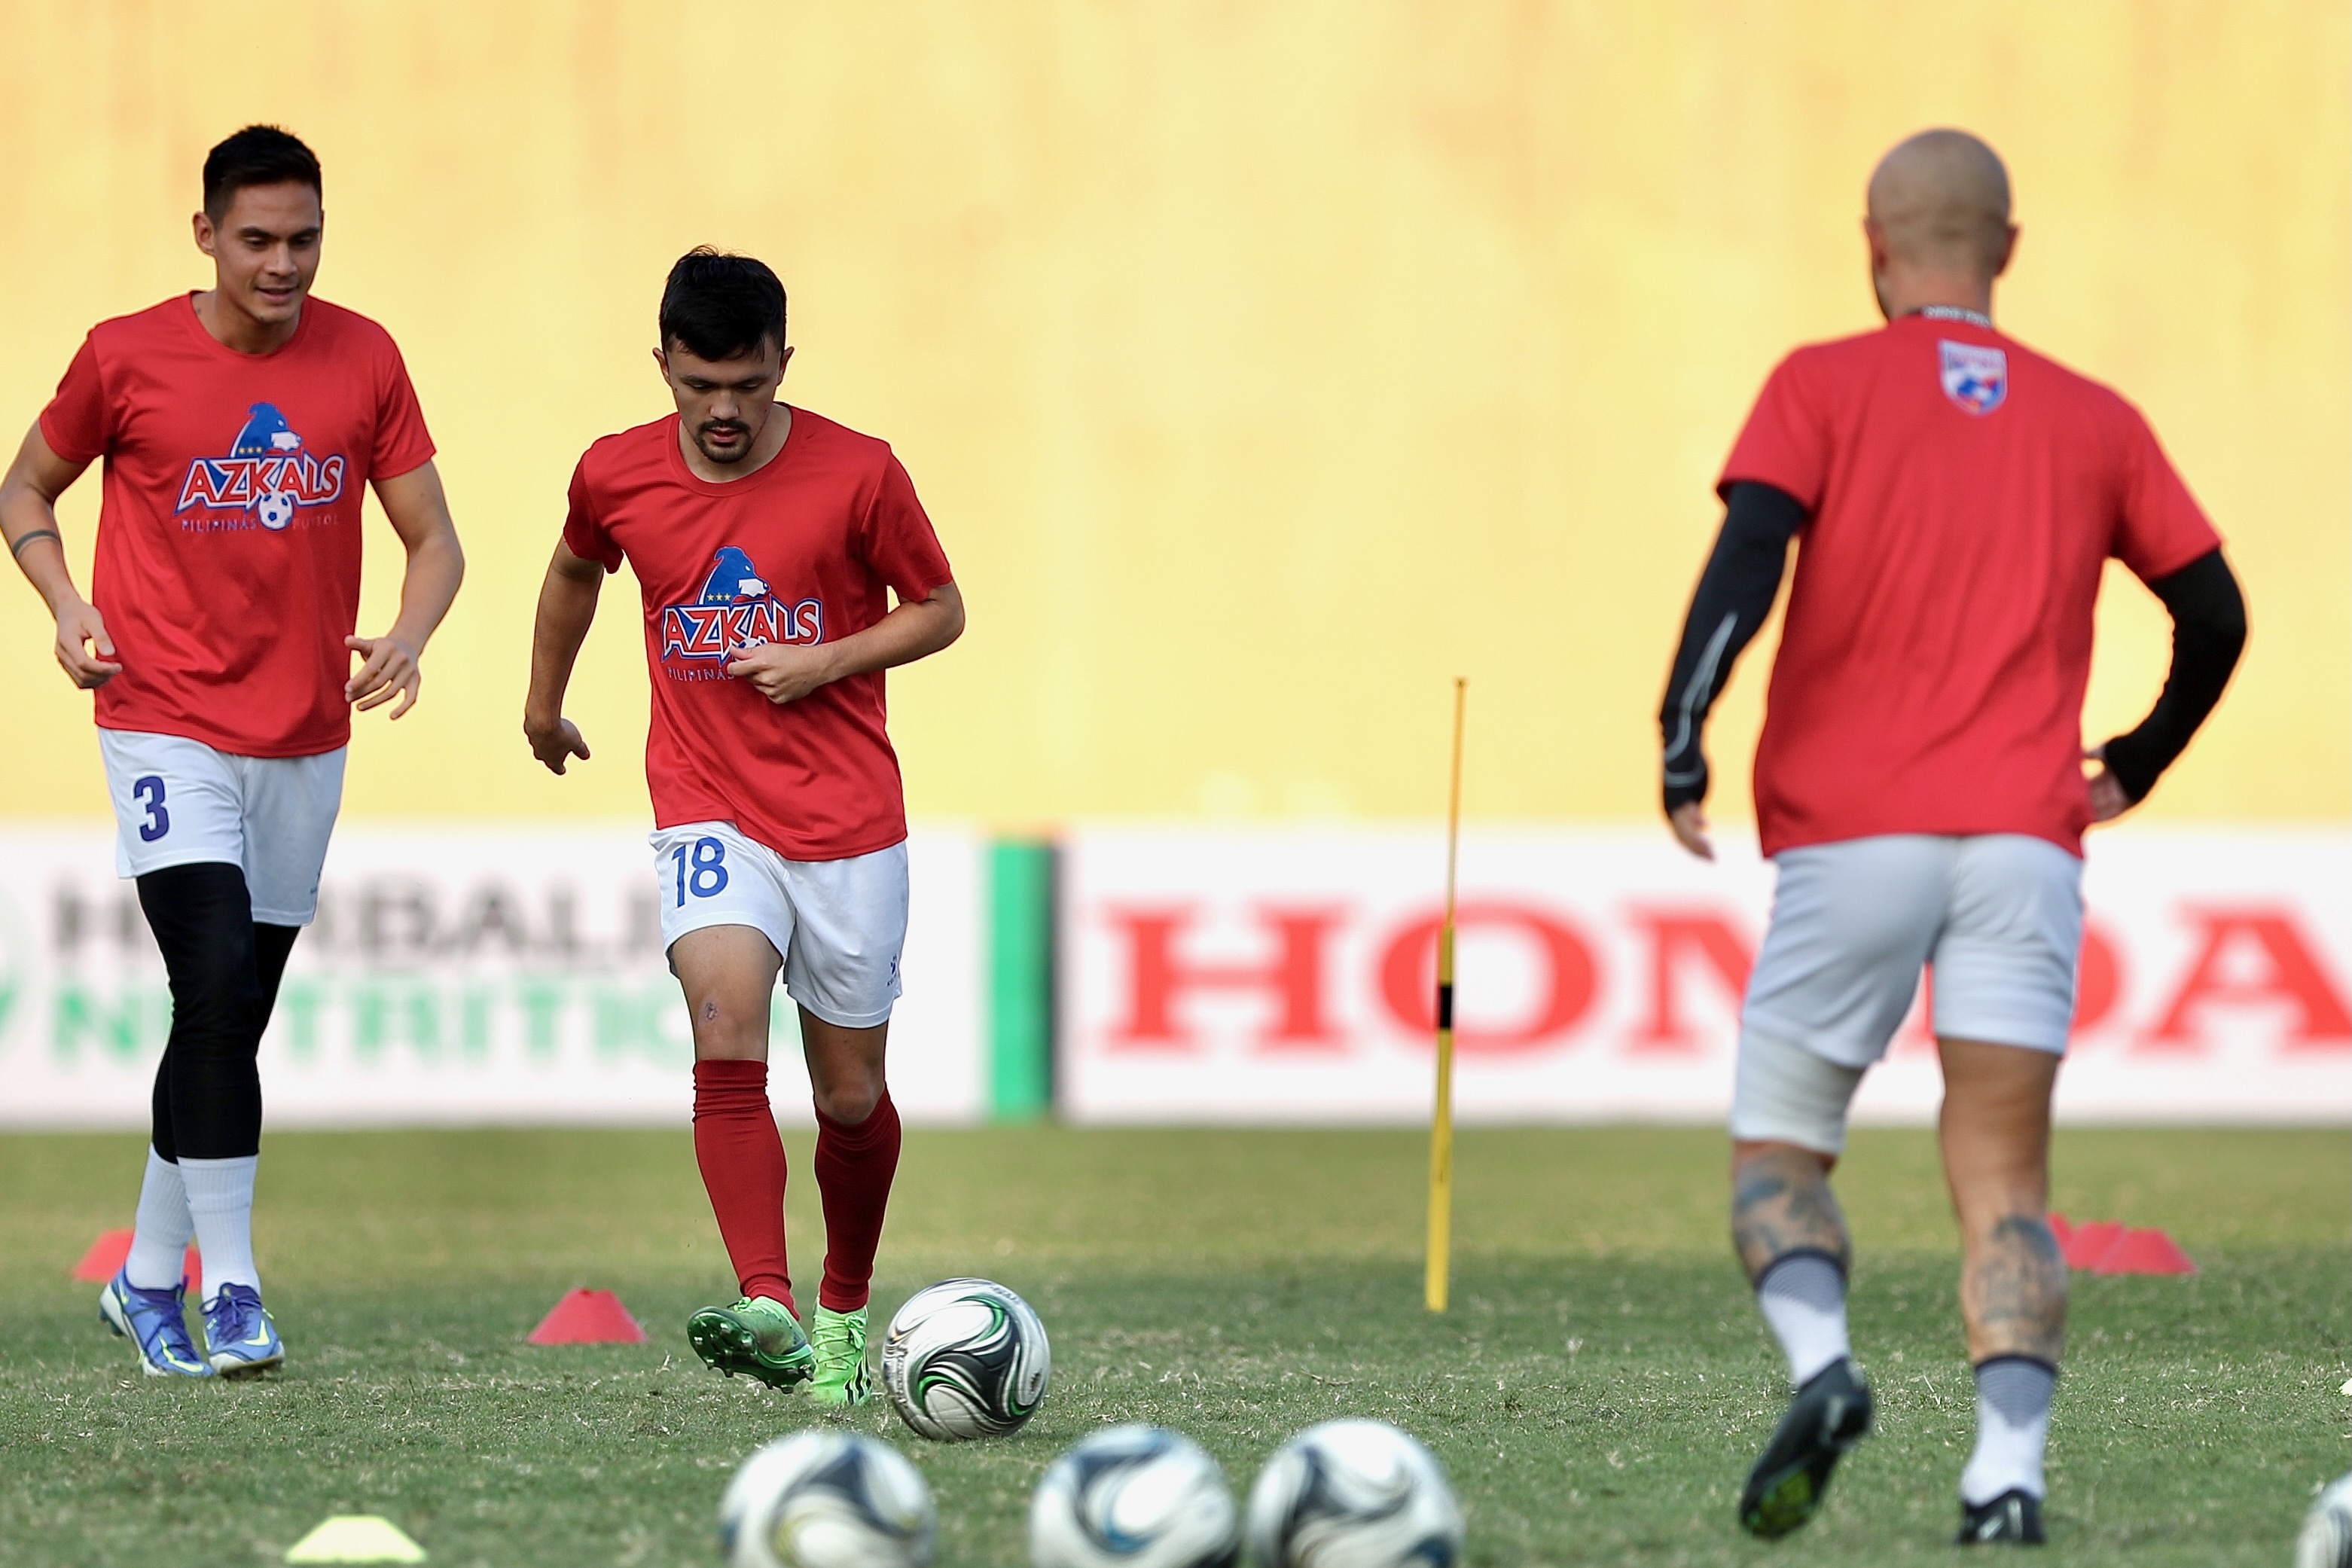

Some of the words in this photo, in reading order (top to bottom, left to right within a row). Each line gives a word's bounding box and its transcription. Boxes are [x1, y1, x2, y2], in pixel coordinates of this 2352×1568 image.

[174, 450, 345, 516] AZKALS
[181, 517, 258, 532] PILIPINAS
[661, 594, 824, 667] AZKALS
[134, 775, 169, 842] 3
[672, 836, 729, 908] 18
